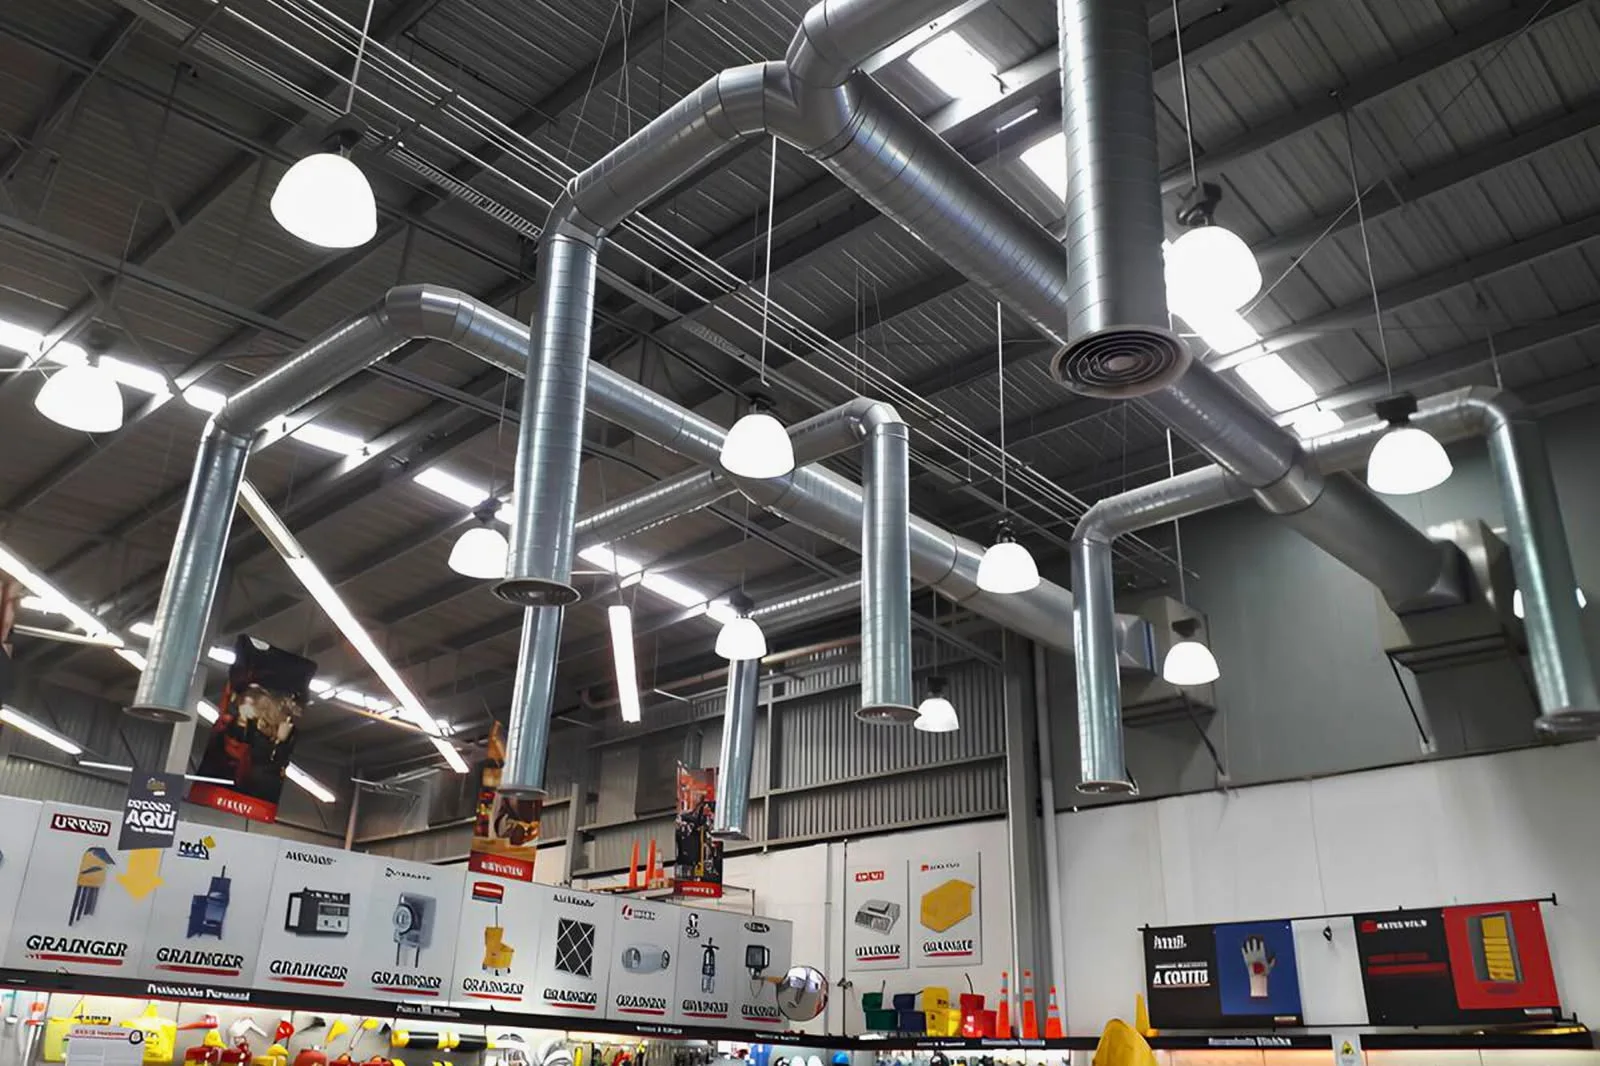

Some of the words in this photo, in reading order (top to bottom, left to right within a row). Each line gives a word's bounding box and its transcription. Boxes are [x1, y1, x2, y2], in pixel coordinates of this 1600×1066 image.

[26, 935, 128, 957] GRAINGER
[156, 947, 244, 969] GRAINGER
[269, 960, 348, 980] GRAINGER
